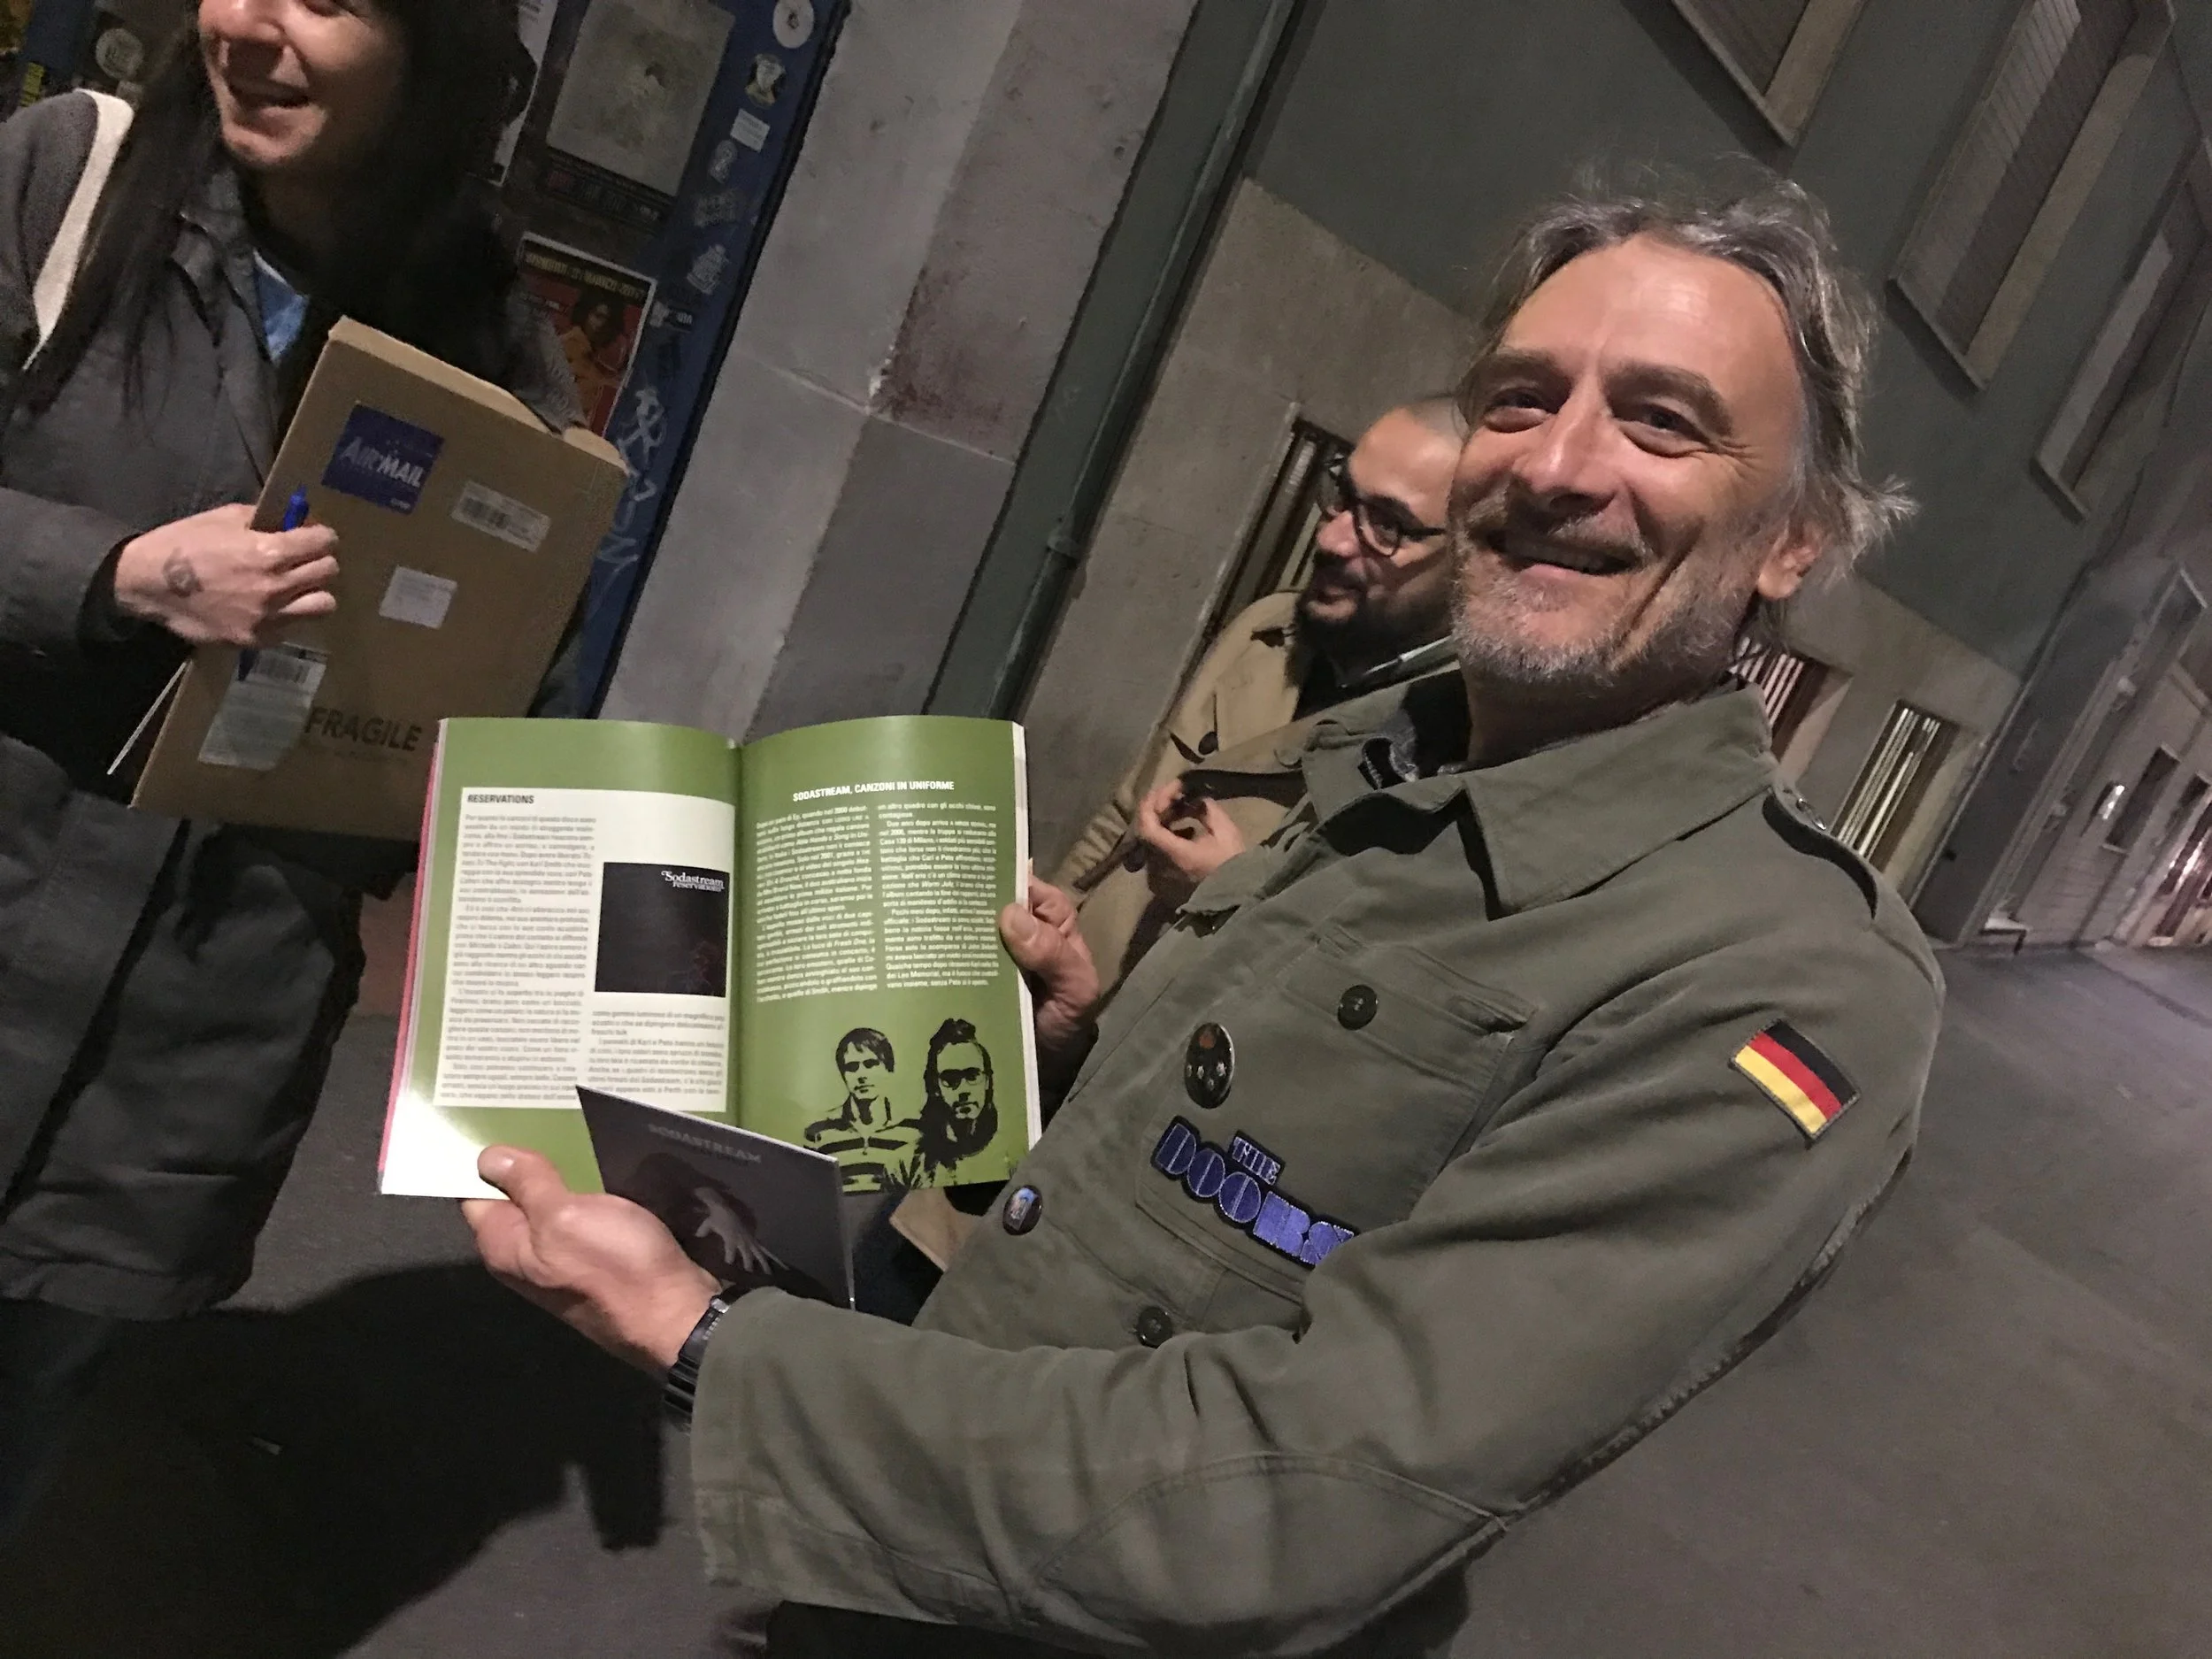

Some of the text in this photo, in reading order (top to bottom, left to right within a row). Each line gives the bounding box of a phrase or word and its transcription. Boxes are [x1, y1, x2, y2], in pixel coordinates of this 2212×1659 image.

[305, 705, 422, 753] FRAGILE
[467, 794, 534, 804] RESERVATIONS
[793, 780, 955, 802] SODASTREAM, CANZONI IN UNIFORME
[661, 870, 725, 889] Sodastream
[1231, 1134, 1282, 1186] THE
